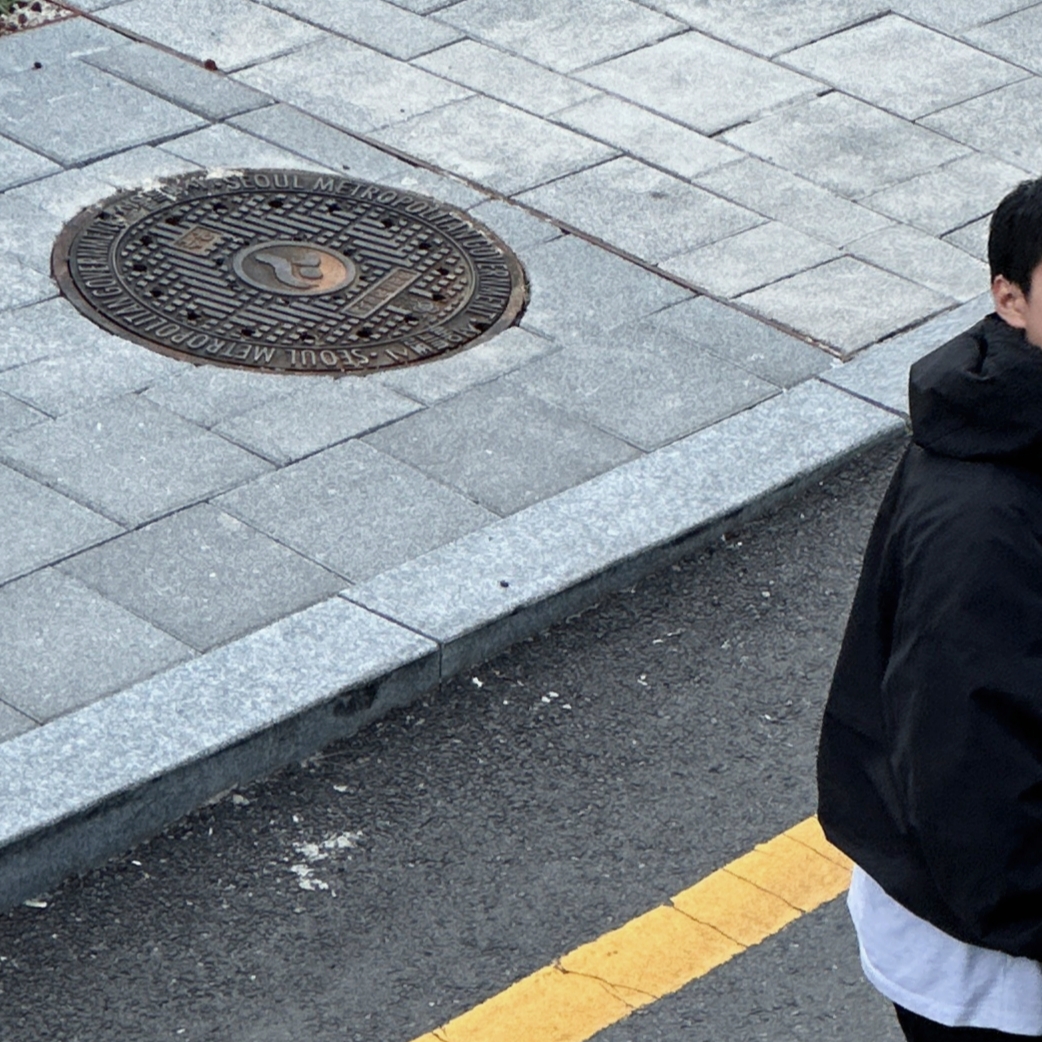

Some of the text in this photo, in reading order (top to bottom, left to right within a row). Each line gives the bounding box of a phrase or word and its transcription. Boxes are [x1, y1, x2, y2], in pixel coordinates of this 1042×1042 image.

[77, 216, 123, 298] GOVERNMENT
[223, 172, 304, 191] SEOUL
[313, 176, 486, 240] METROPOLITAN
[462, 239, 511, 320] GOVERNMENT
[101, 296, 277, 364] METROPOLITAN
[287, 347, 370, 367] SEOUL
